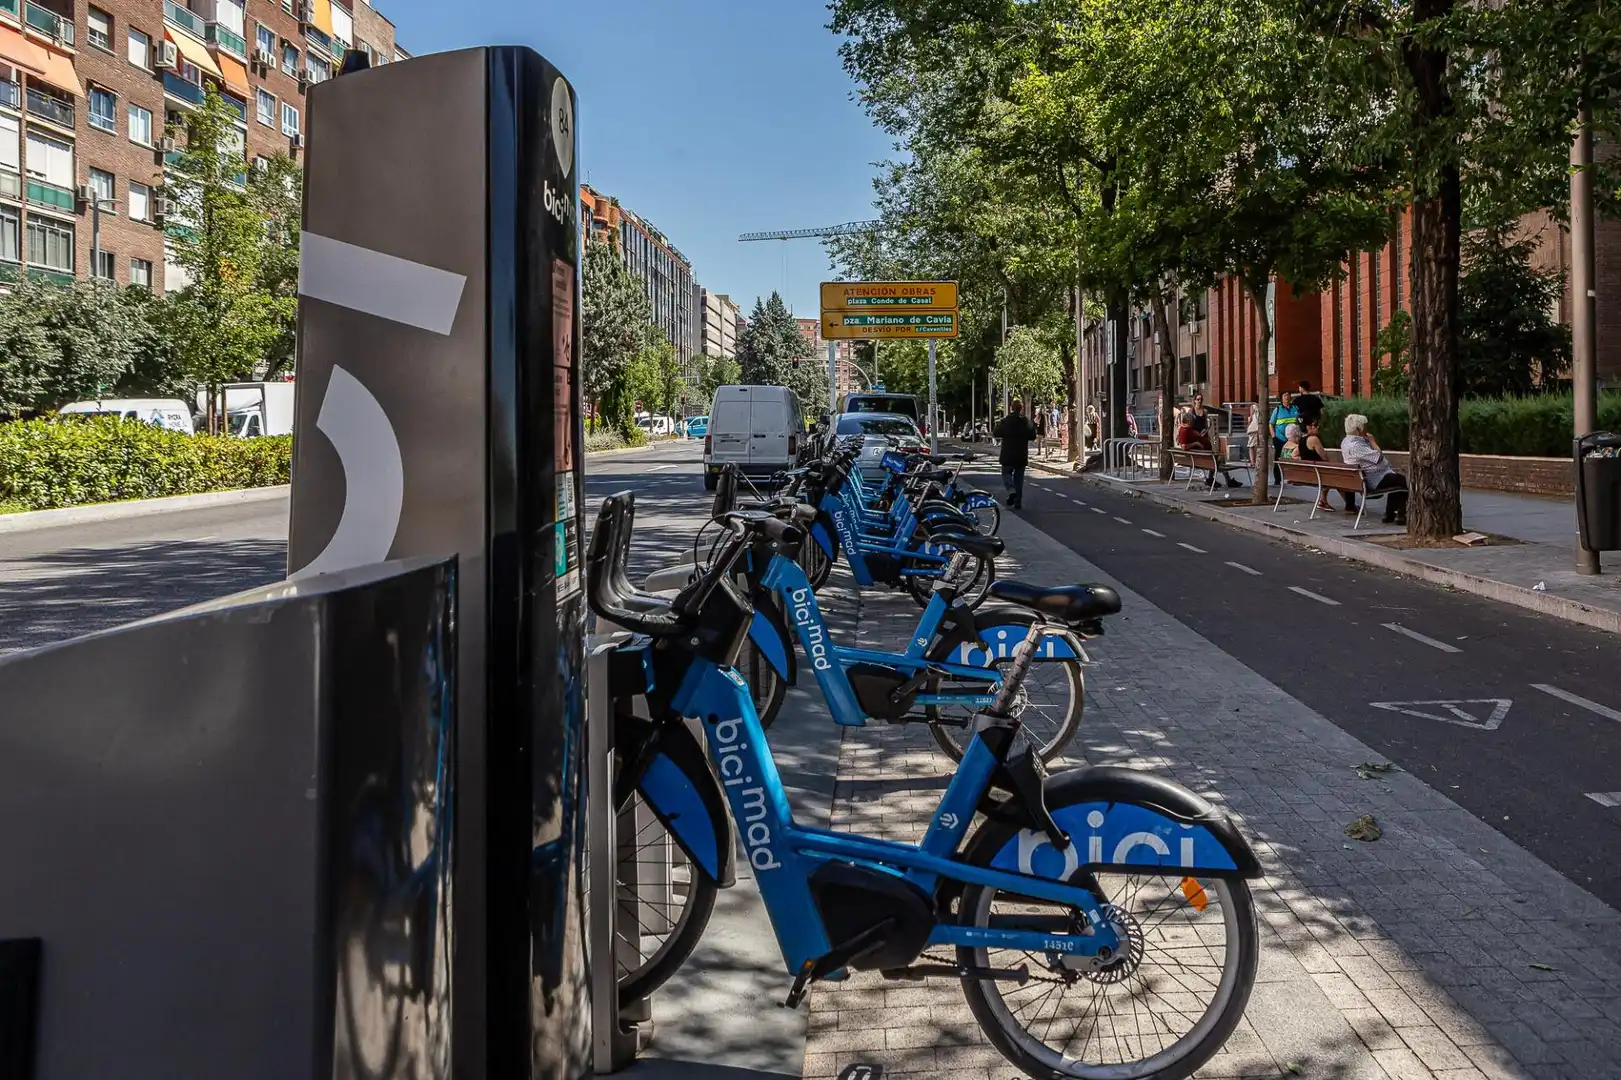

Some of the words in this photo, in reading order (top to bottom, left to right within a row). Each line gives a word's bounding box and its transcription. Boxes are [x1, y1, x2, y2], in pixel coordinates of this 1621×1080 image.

[558, 107, 570, 139] 84
[844, 287, 897, 296] ATENCIÓN
[901, 287, 937, 296] OBRAS
[867, 316, 905, 324] Mariano
[909, 316, 921, 324] de
[926, 315, 952, 324] Cavia
